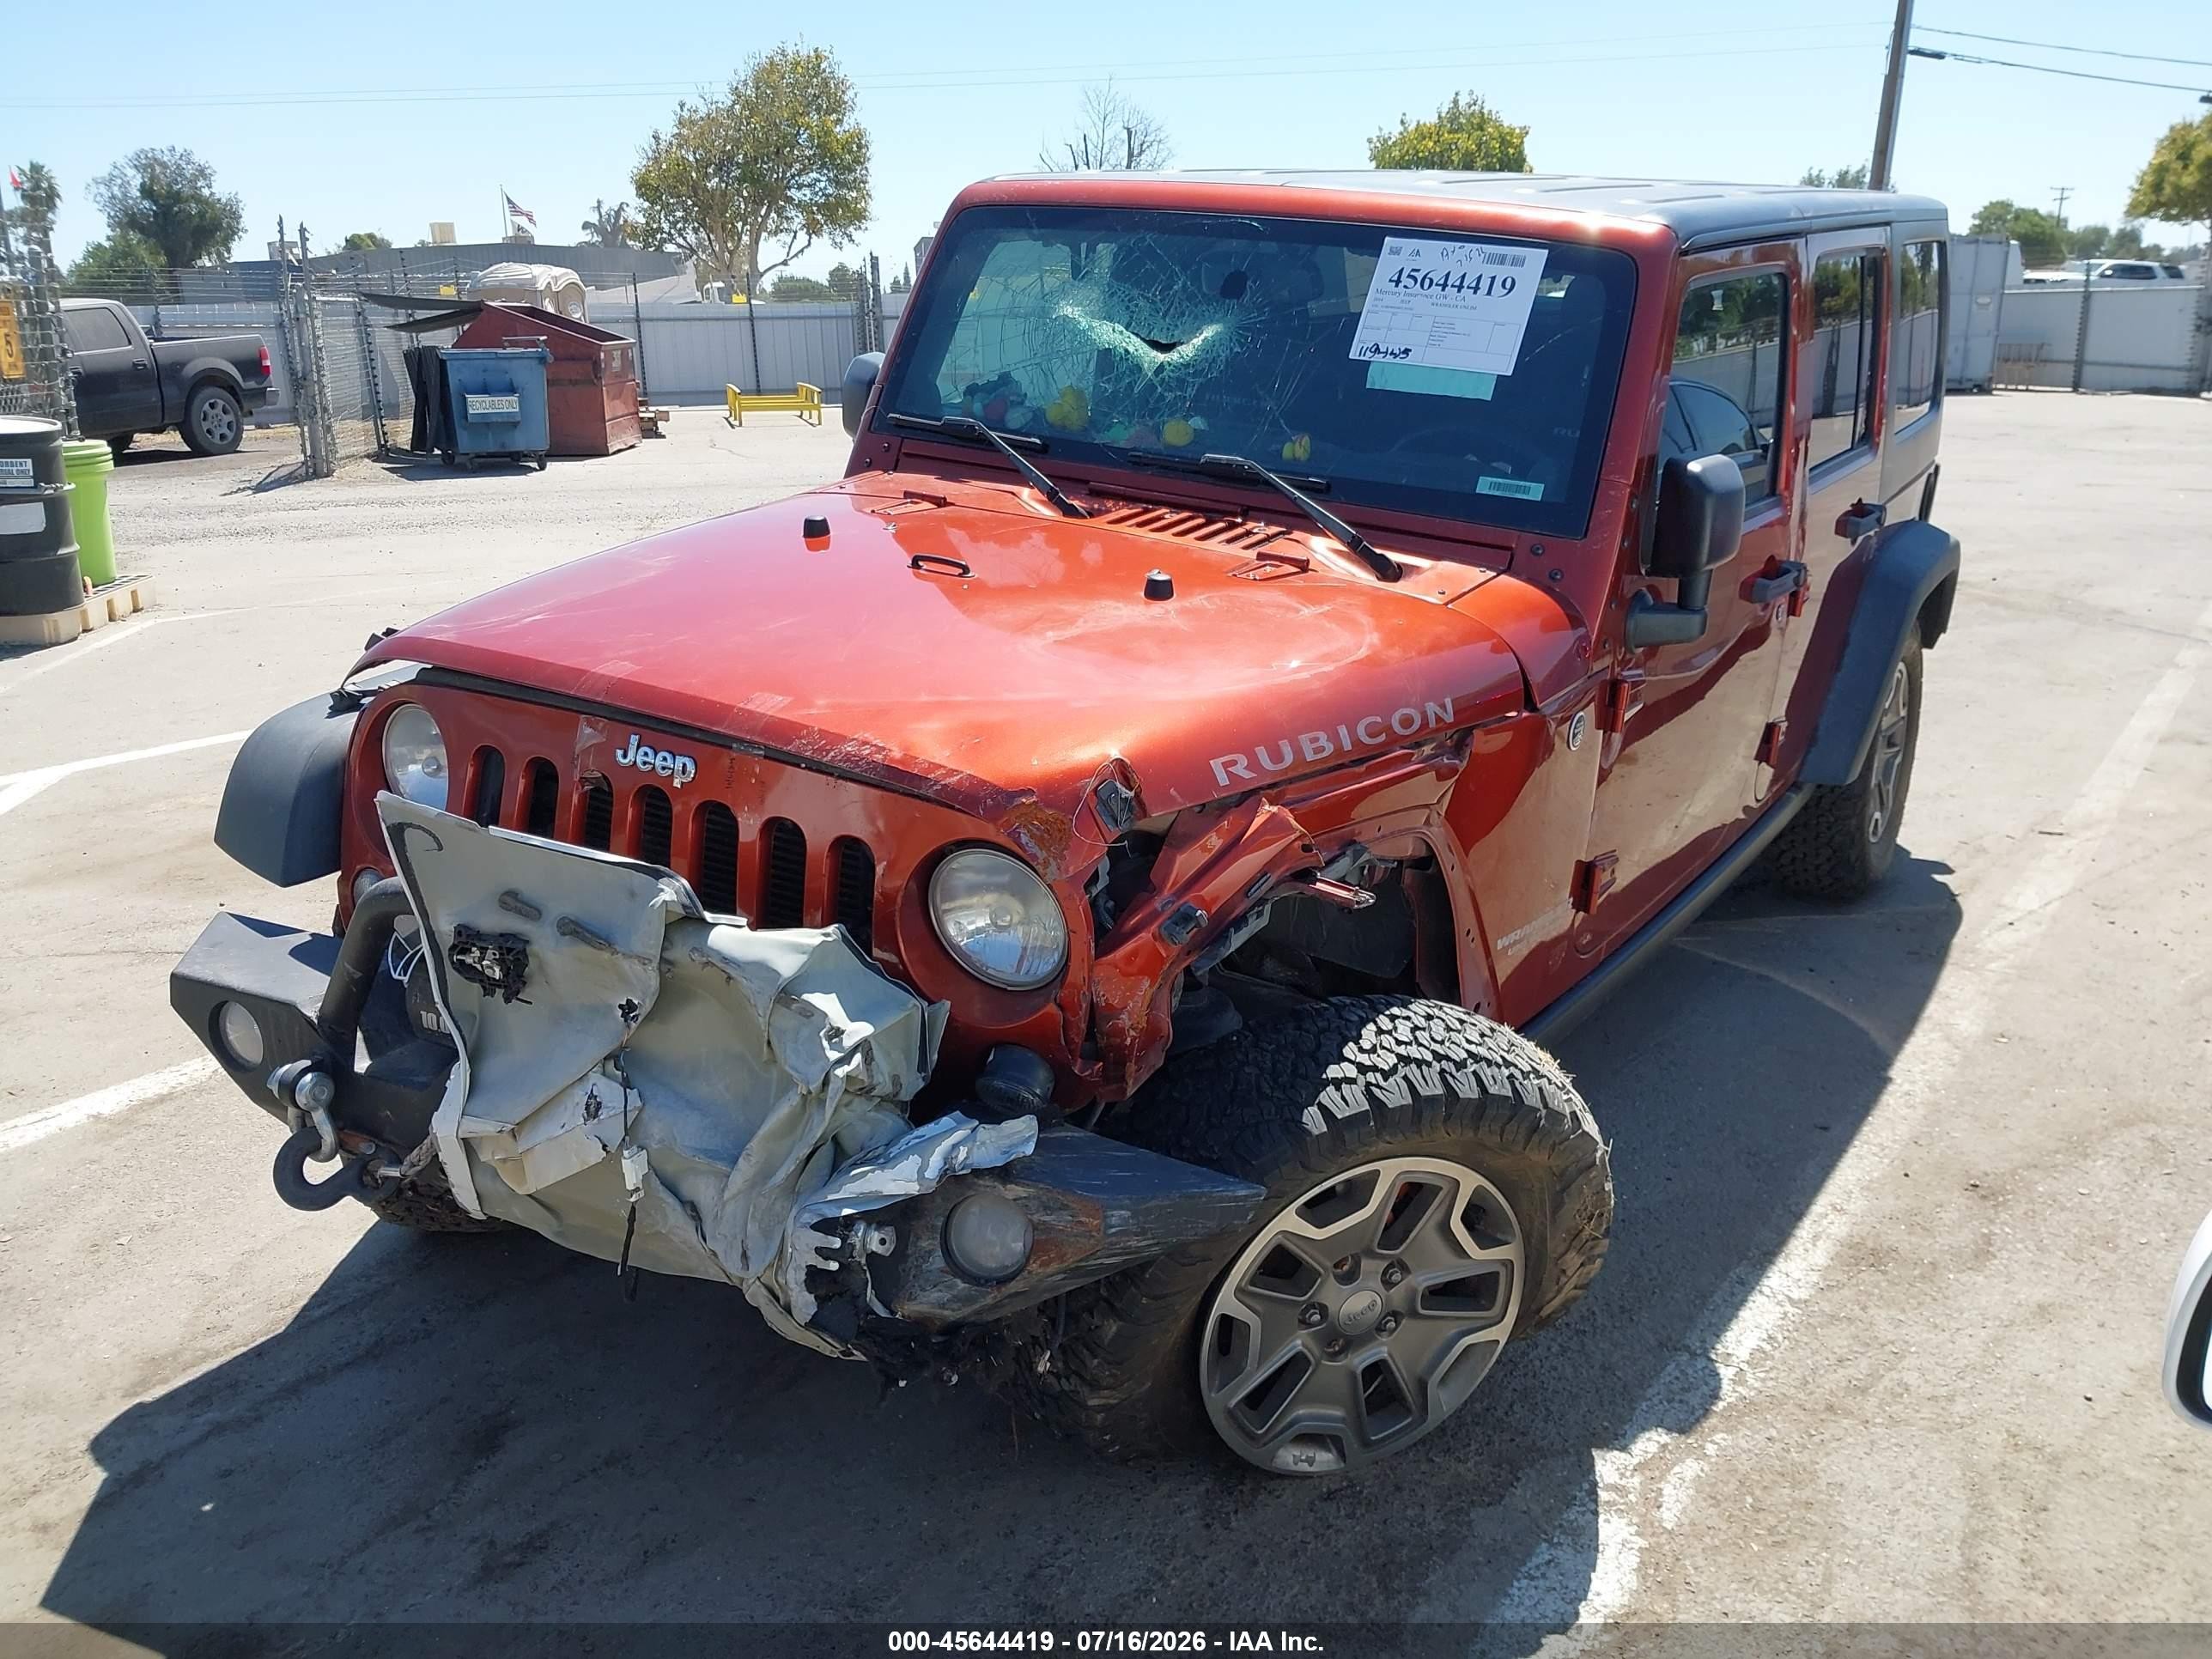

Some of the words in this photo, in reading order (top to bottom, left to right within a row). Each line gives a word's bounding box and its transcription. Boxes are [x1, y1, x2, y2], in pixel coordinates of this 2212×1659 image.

[1375, 288, 1401, 298] Mercury
[1455, 295, 1467, 303] CA
[1388, 266, 1516, 298] 45644419
[469, 398, 505, 410] RECYCLABLES
[505, 398, 518, 410] ONLY
[1209, 697, 1455, 787] RUBICON
[616, 734, 696, 789] Jeep
